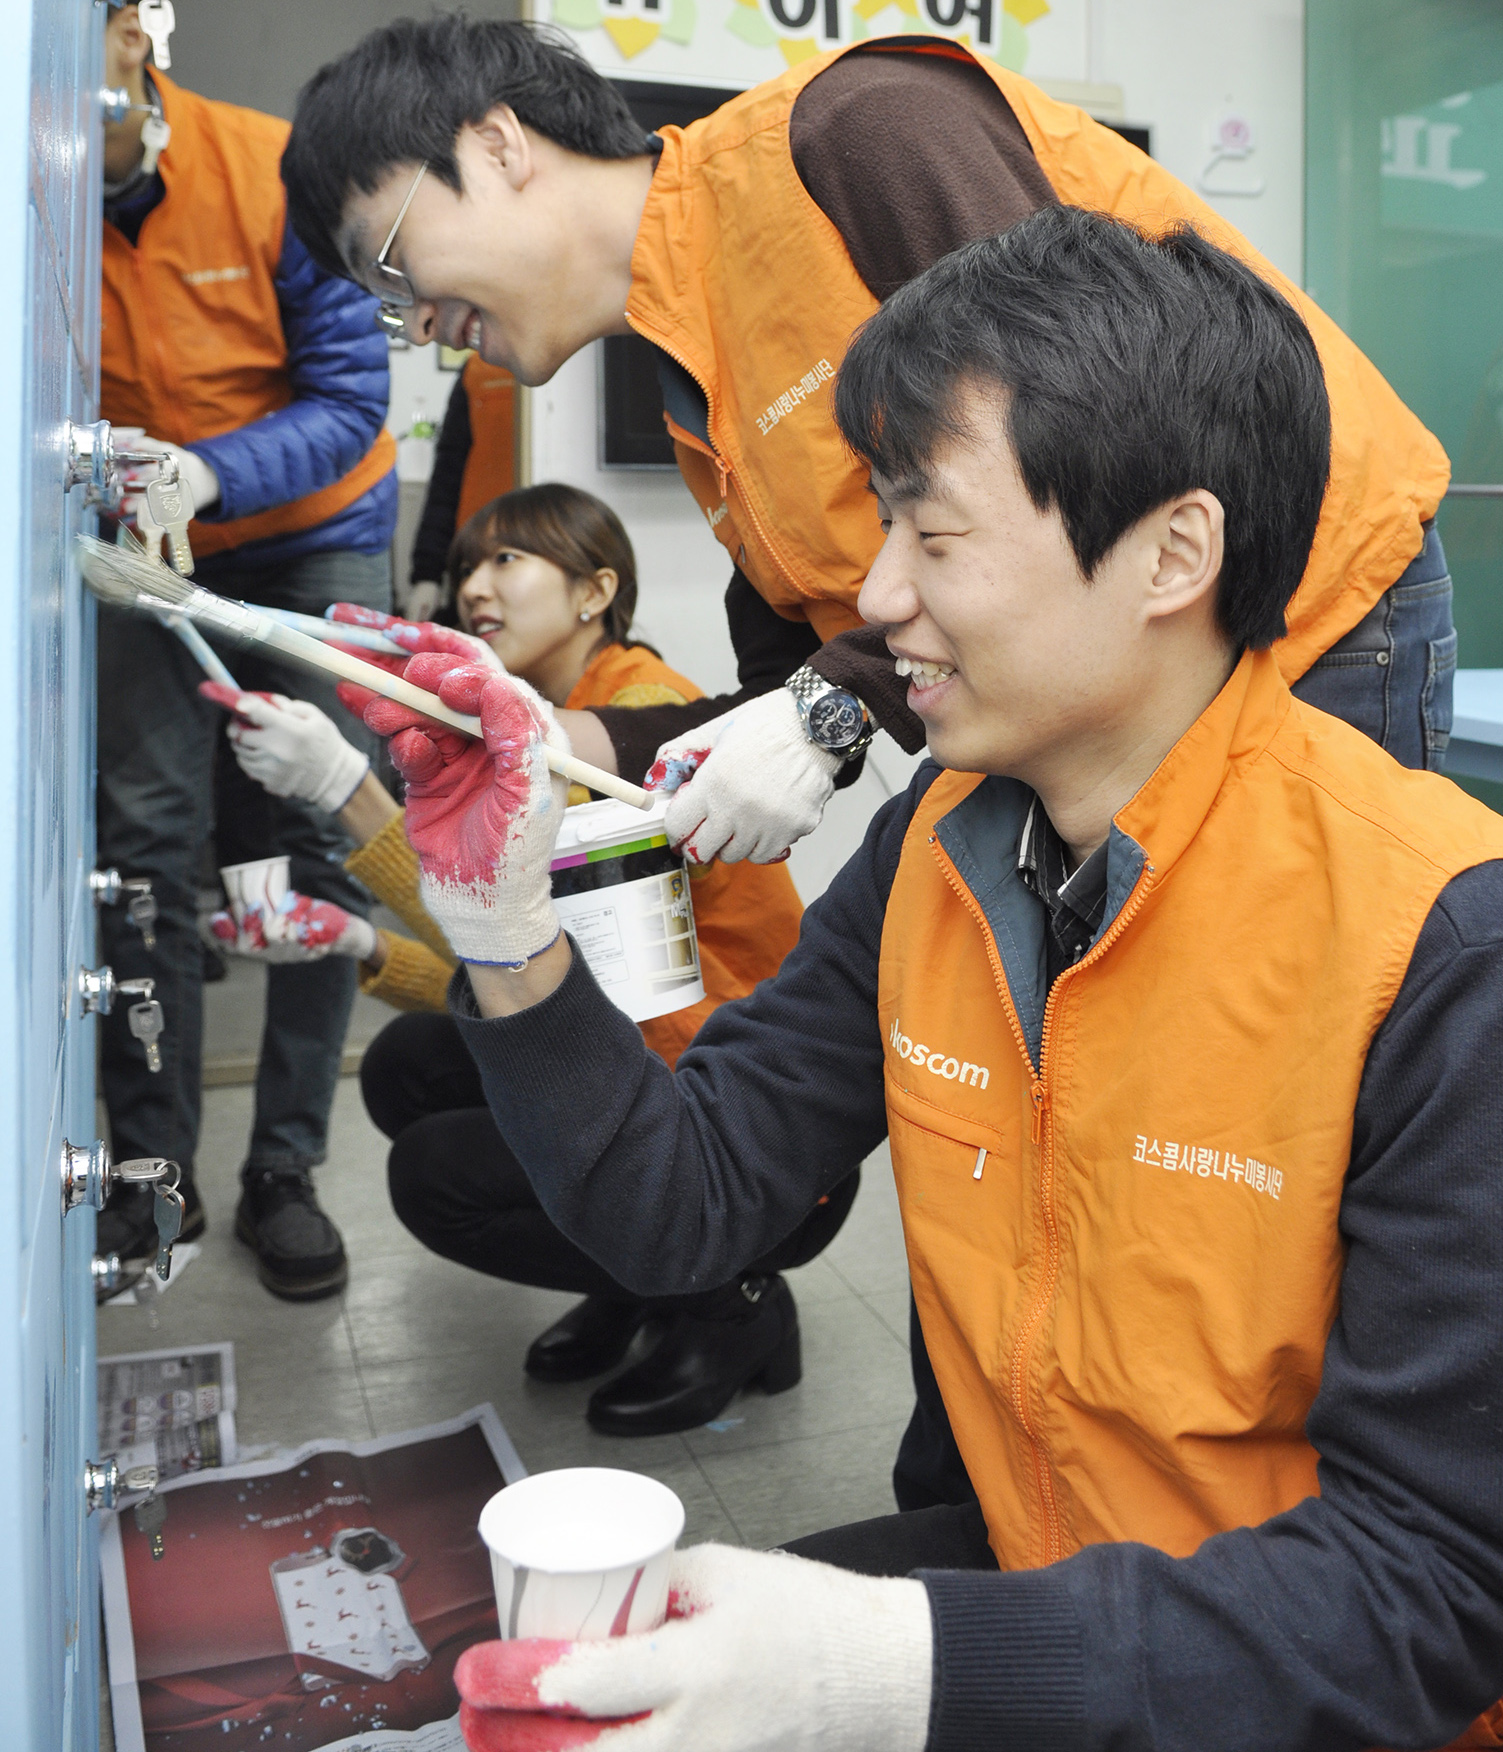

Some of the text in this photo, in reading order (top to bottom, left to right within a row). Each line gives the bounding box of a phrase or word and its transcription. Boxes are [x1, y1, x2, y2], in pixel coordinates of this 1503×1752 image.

[755, 358, 836, 436] 코스콤사랑나누미봉사단
[889, 1018, 990, 1090] koscom
[1132, 1134, 1284, 1201] 코스콤사랑나누미봉사단
